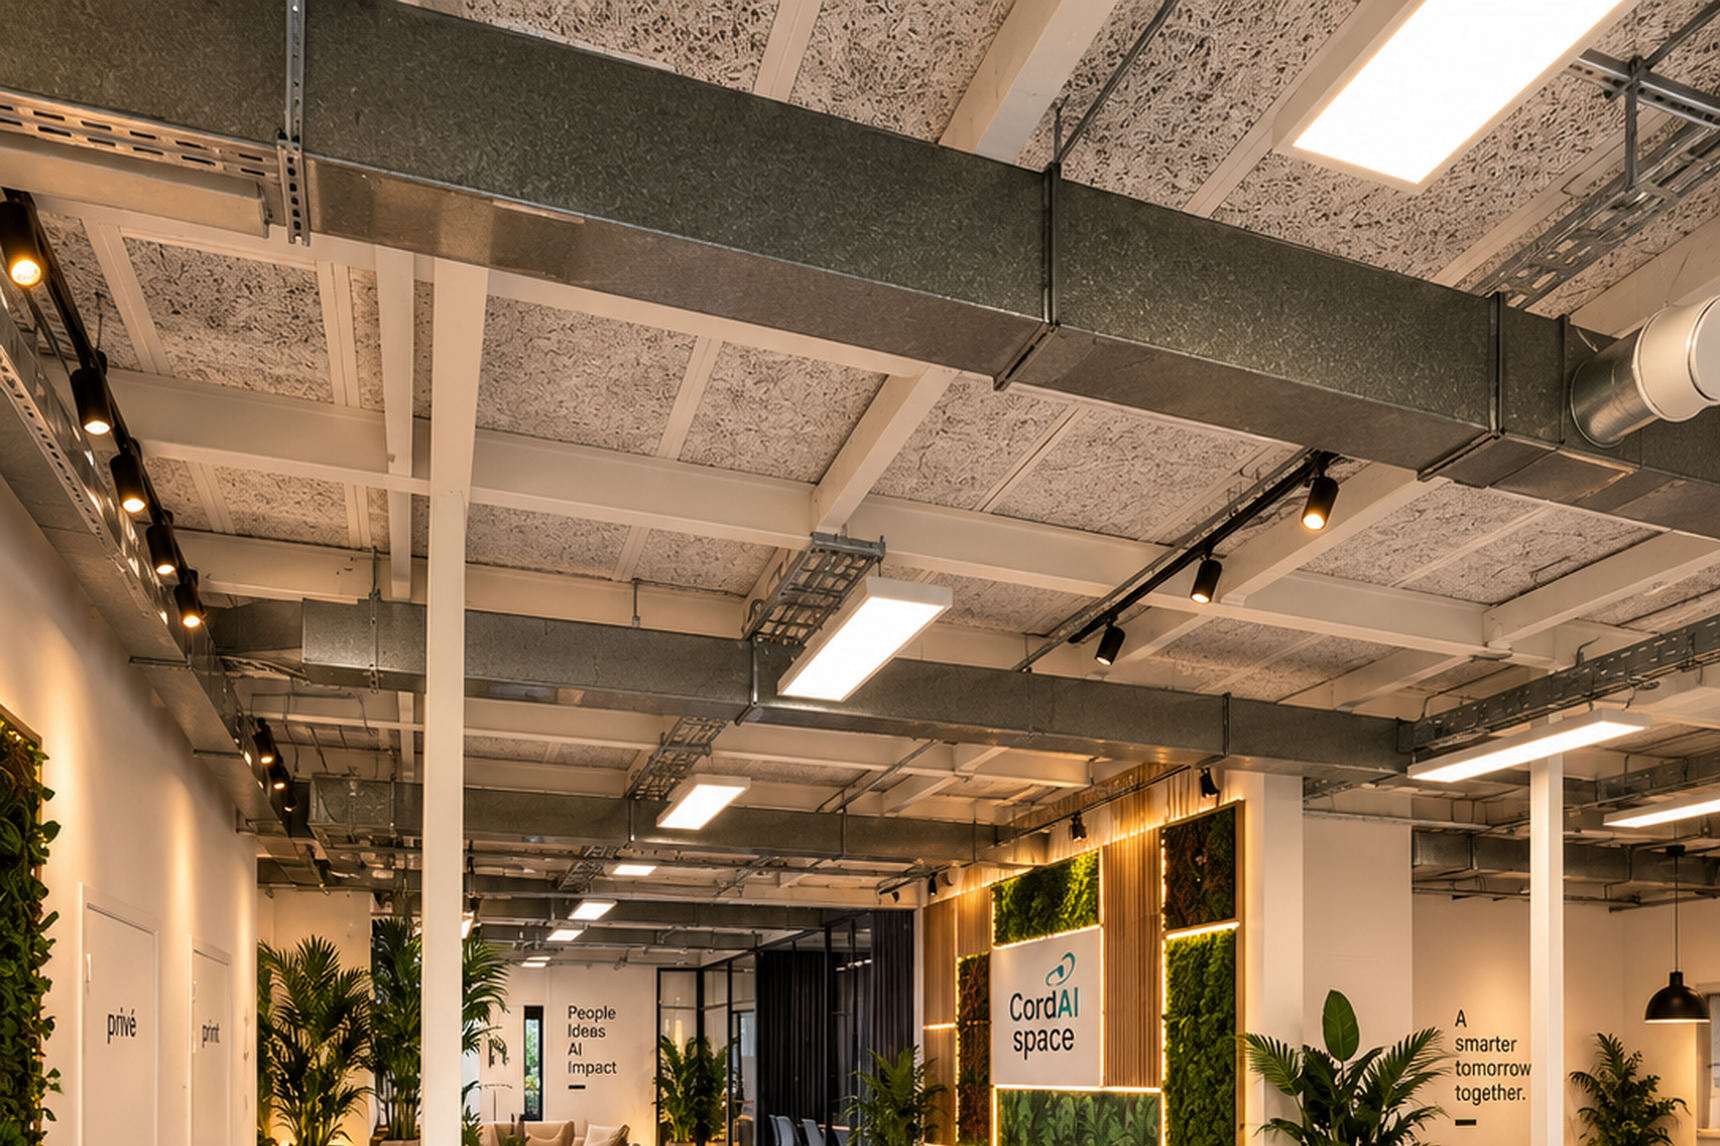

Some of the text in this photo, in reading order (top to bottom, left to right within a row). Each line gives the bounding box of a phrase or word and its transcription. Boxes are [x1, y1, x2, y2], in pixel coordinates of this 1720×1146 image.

[1009, 986, 1079, 1022] CordAI
[568, 1005, 616, 1023] People
[1455, 1009, 1467, 1028] A
[107, 1007, 137, 1044] privé
[568, 1024, 606, 1038] Ideas
[568, 1042, 582, 1056] AI
[1013, 1028, 1075, 1060] space
[1455, 1036, 1518, 1052] smarter
[568, 1061, 617, 1077] Impact
[1455, 1060, 1532, 1076] tomorrow
[1455, 1083, 1526, 1106] together.
